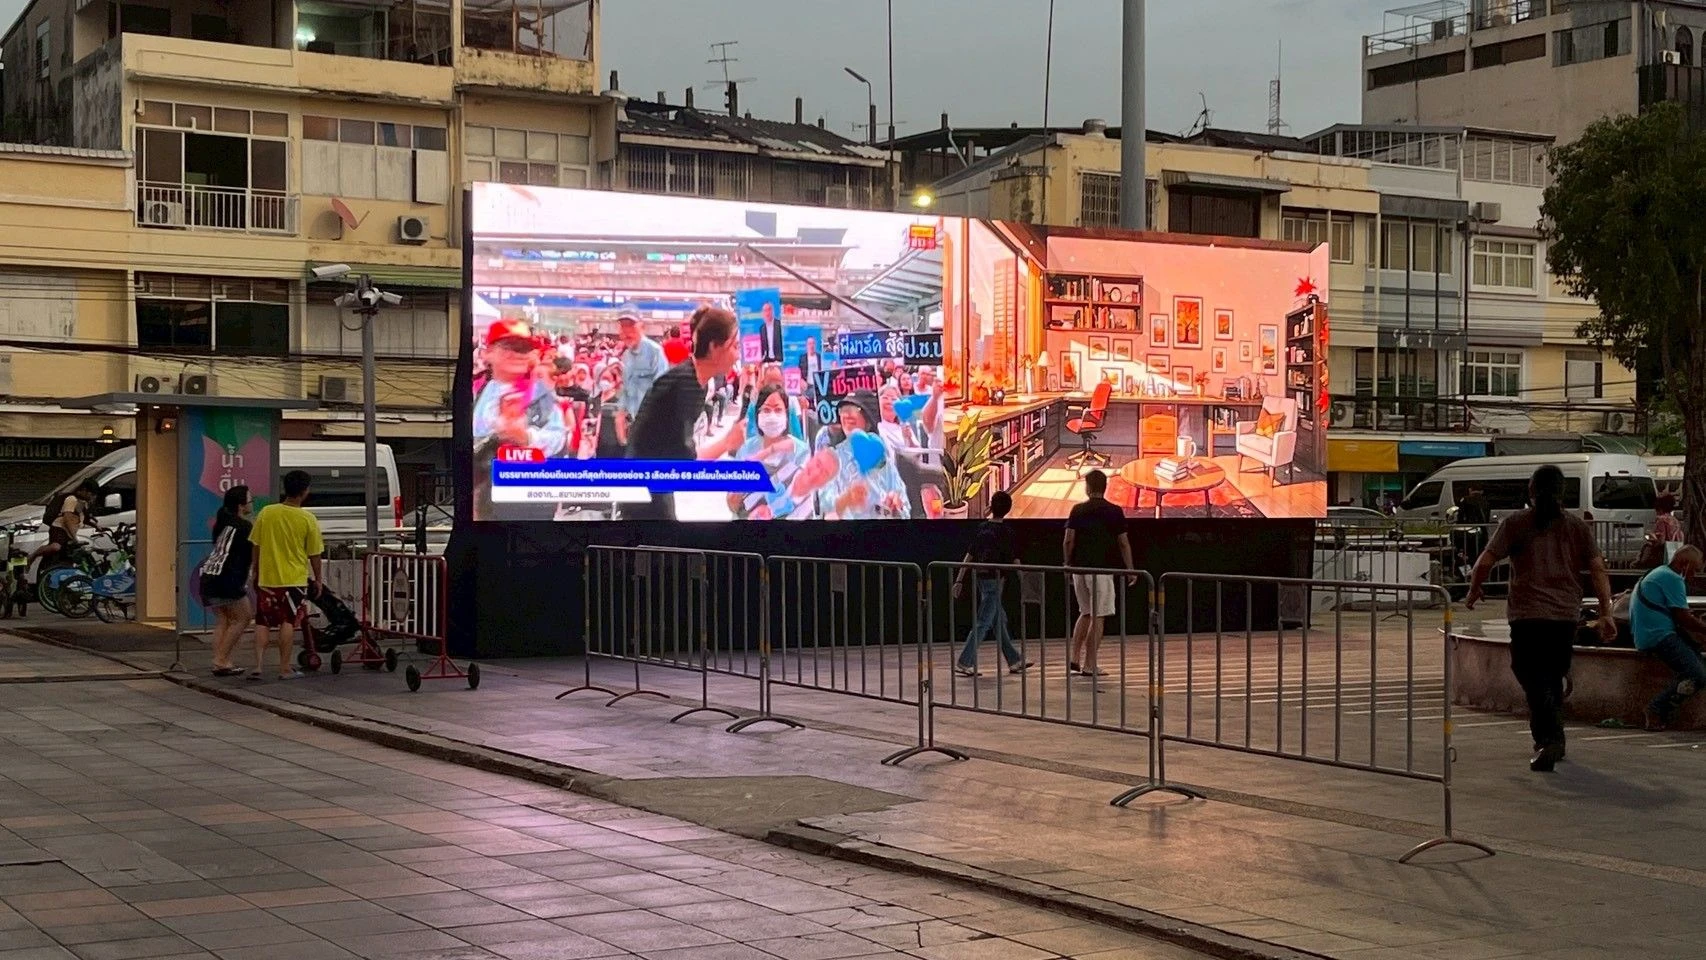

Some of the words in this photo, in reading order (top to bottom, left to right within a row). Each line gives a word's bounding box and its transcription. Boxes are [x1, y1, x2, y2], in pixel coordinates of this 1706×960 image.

[745, 347, 758, 358] 27
[787, 379, 799, 389] 27
[221, 443, 244, 468] น้ำ
[505, 448, 533, 461] LIVE
[645, 471, 650, 480] 3
[651, 468, 680, 480] เลือกตั้ง
[681, 471, 692, 480] 69
